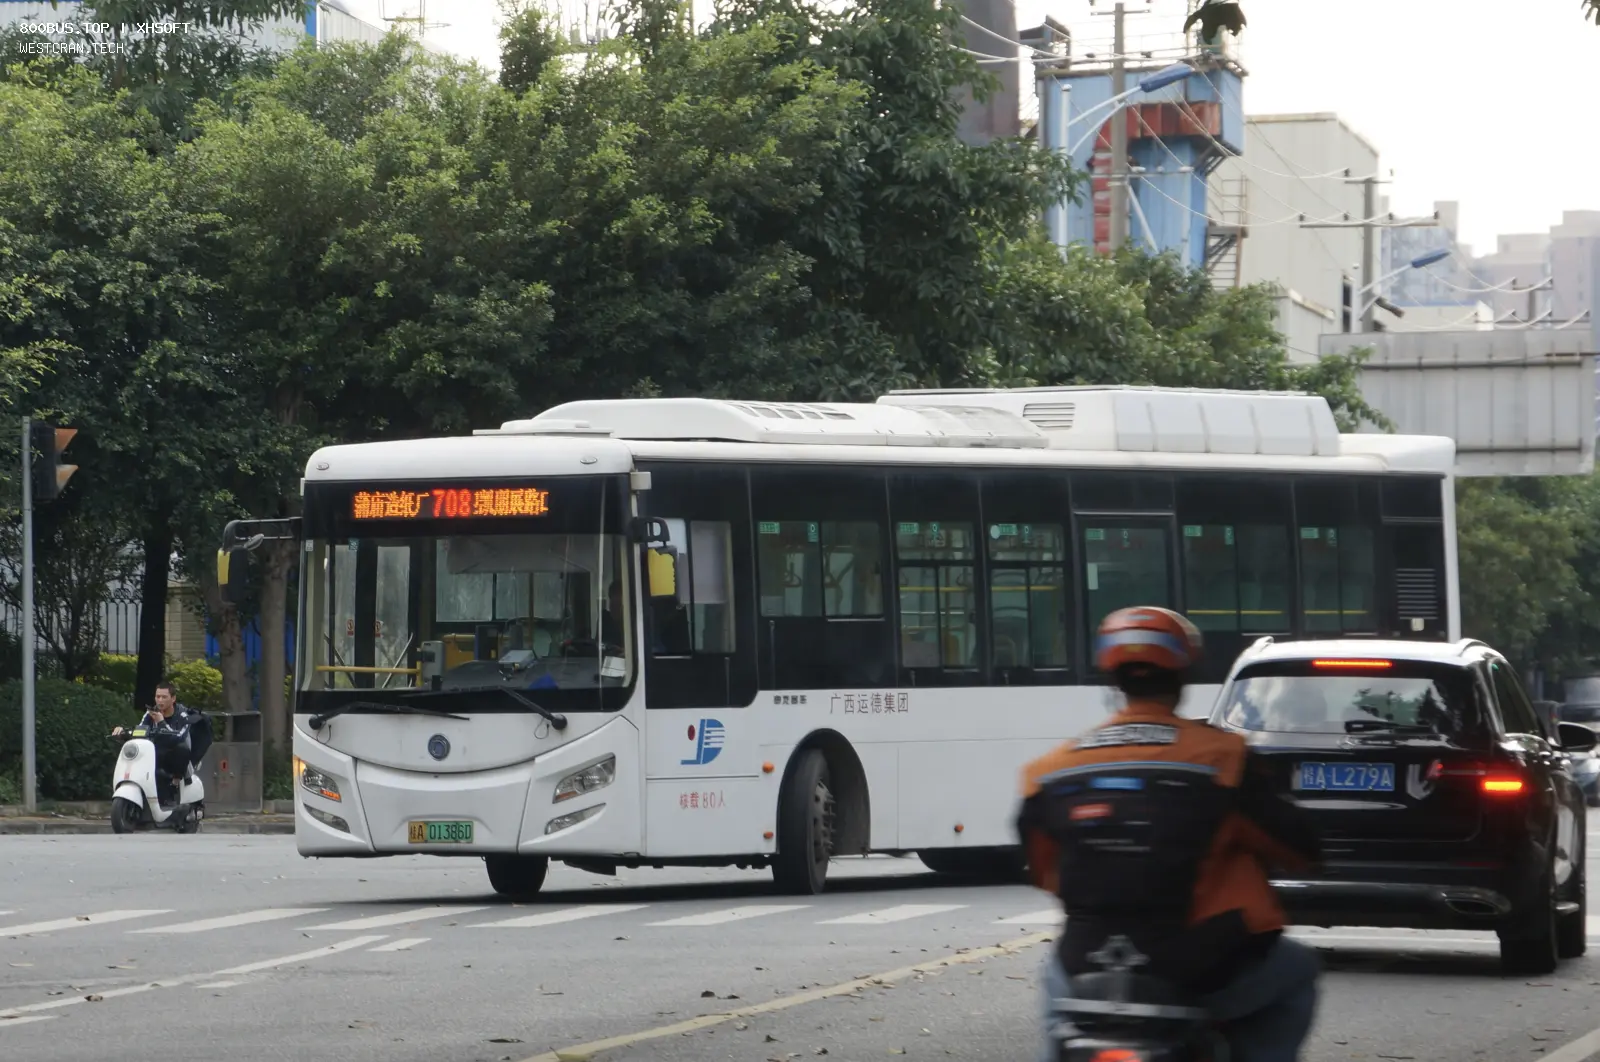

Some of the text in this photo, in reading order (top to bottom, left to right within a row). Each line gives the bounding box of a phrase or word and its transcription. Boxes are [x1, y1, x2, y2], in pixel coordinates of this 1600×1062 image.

[354, 490, 430, 518] 蒲庙造纸厂
[432, 489, 472, 517] 708
[830, 692, 909, 714] 广西运德集团
